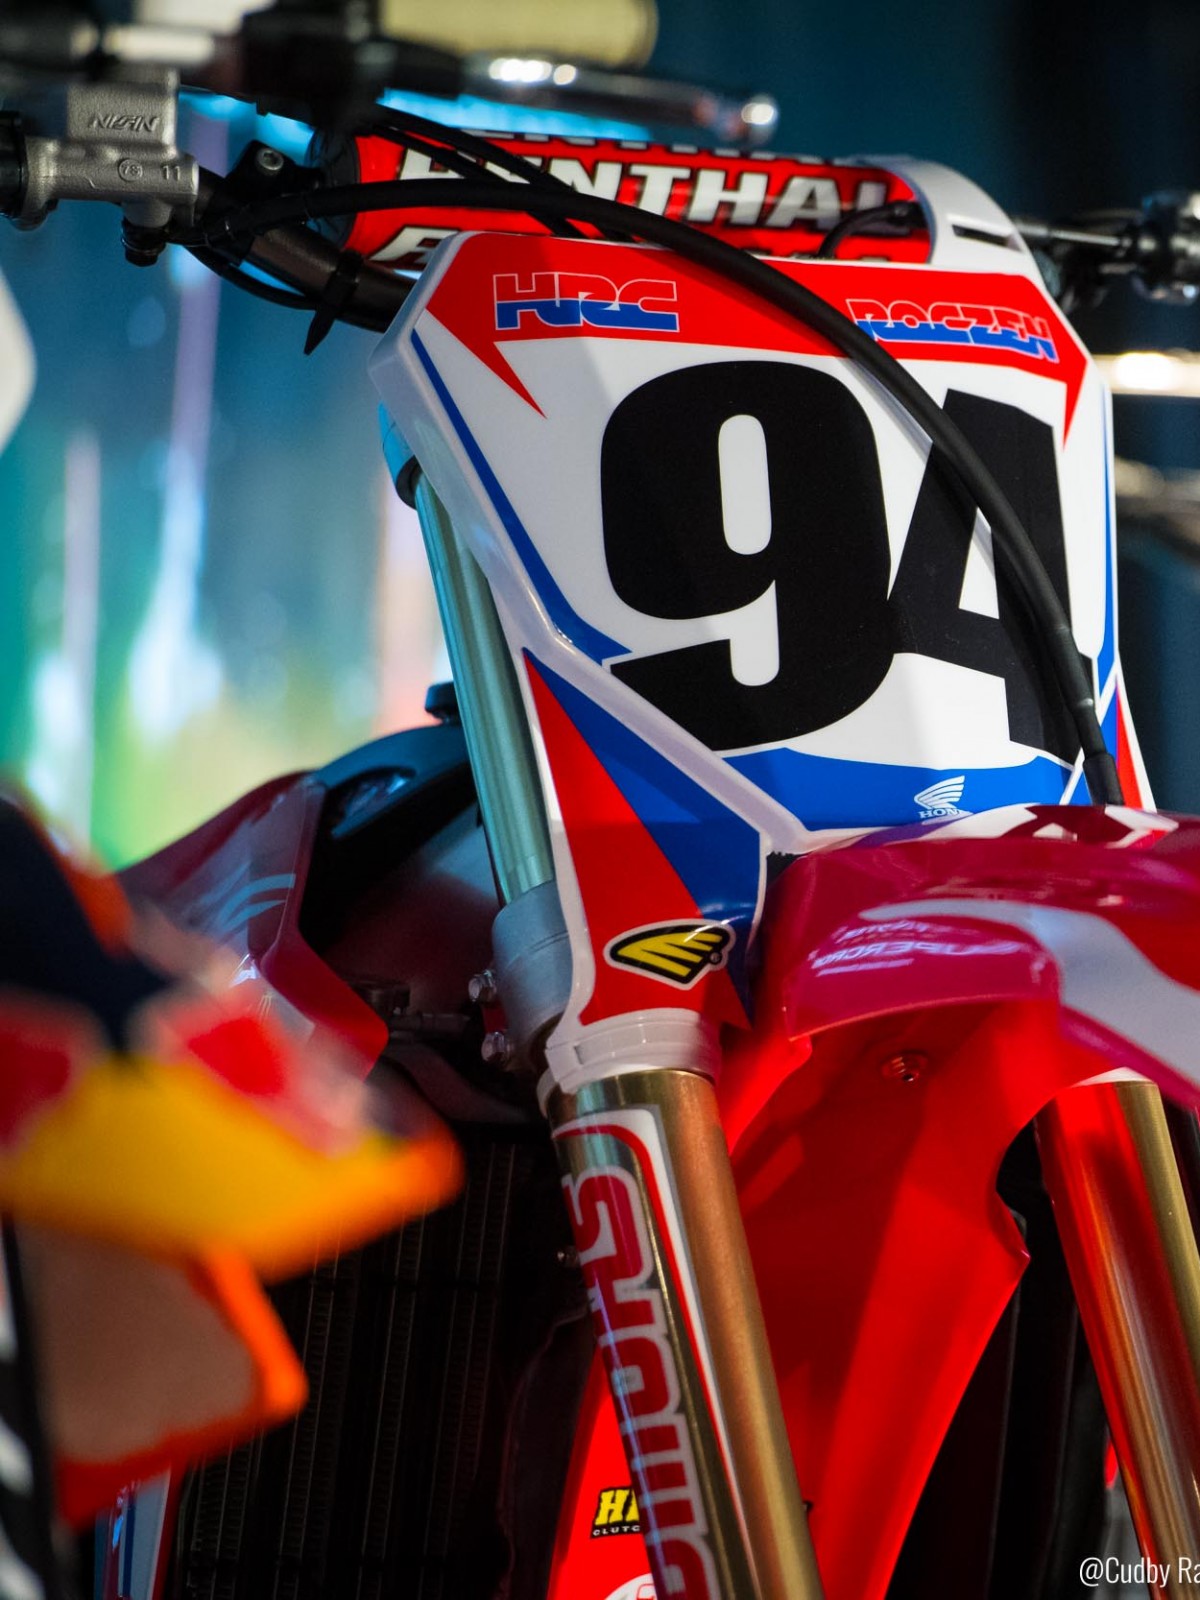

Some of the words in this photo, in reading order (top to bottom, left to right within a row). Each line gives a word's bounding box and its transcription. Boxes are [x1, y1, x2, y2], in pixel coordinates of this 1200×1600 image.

[493, 271, 680, 332] HRC
[846, 298, 1060, 364] ROCZEN
[600, 360, 1093, 770] 94
[592, 1525, 640, 1536] CLUTC
